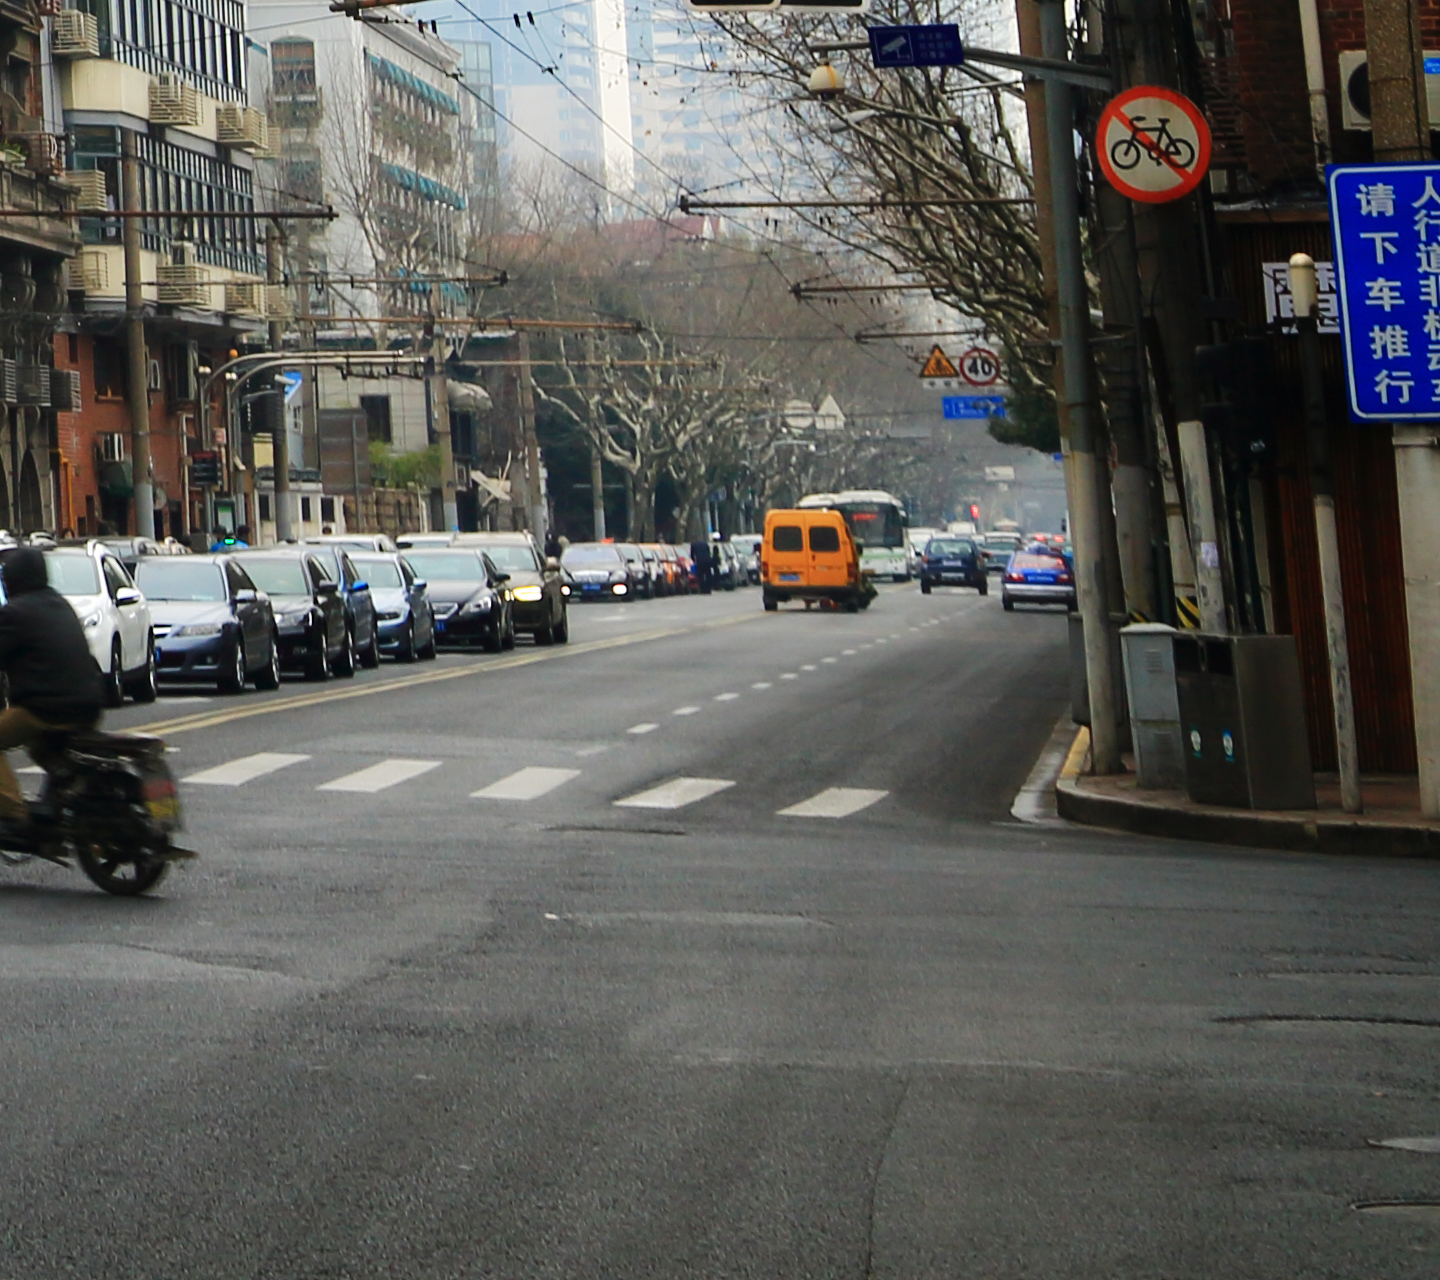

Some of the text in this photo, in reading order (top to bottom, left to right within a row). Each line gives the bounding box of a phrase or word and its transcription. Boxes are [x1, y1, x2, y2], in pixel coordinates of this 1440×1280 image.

[1356, 183, 1415, 404] 请下车推行
[968, 357, 992, 376] 40
